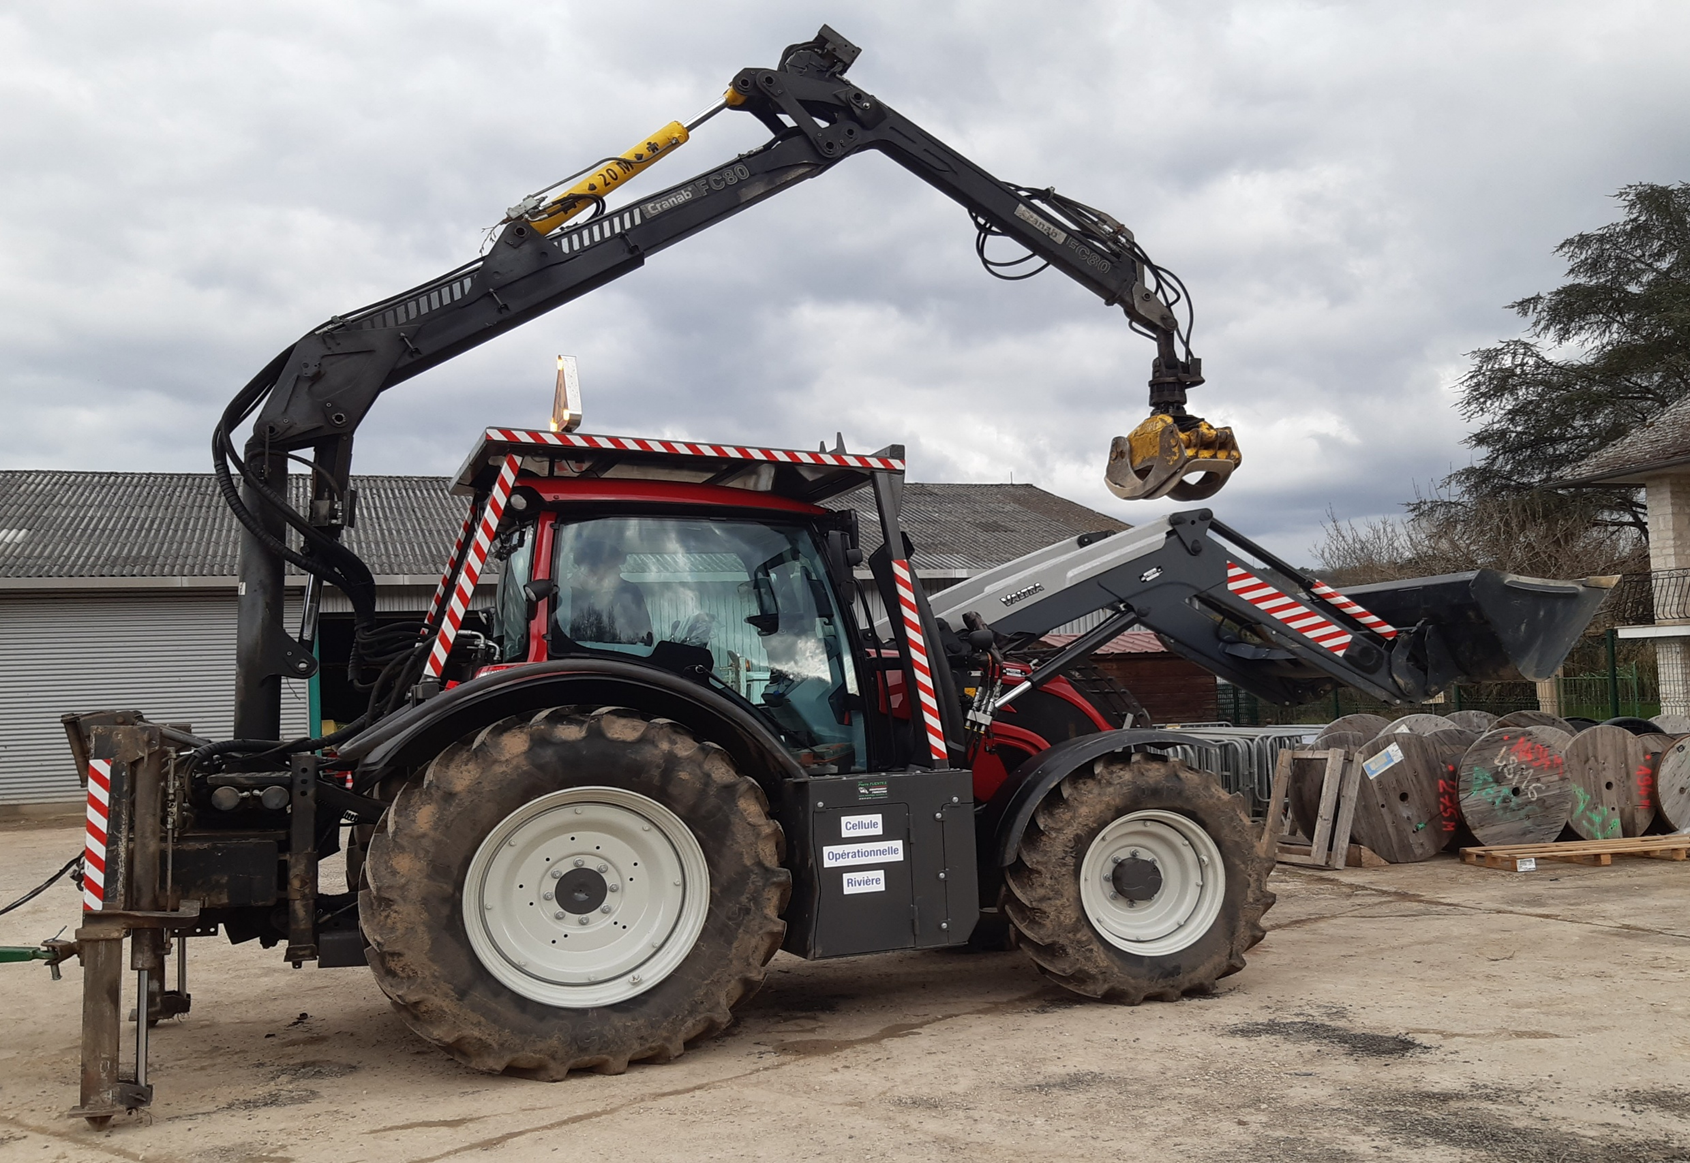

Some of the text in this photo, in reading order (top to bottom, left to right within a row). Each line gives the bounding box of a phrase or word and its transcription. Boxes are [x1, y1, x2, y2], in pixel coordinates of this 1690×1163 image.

[598, 160, 634, 187] 20 M
[647, 164, 750, 214] Cranab FC80
[999, 582, 1045, 607] VALTRA
[845, 820, 878, 830] Cellule
[827, 846, 899, 861] Opérationnelle
[847, 876, 881, 887] Rivière
